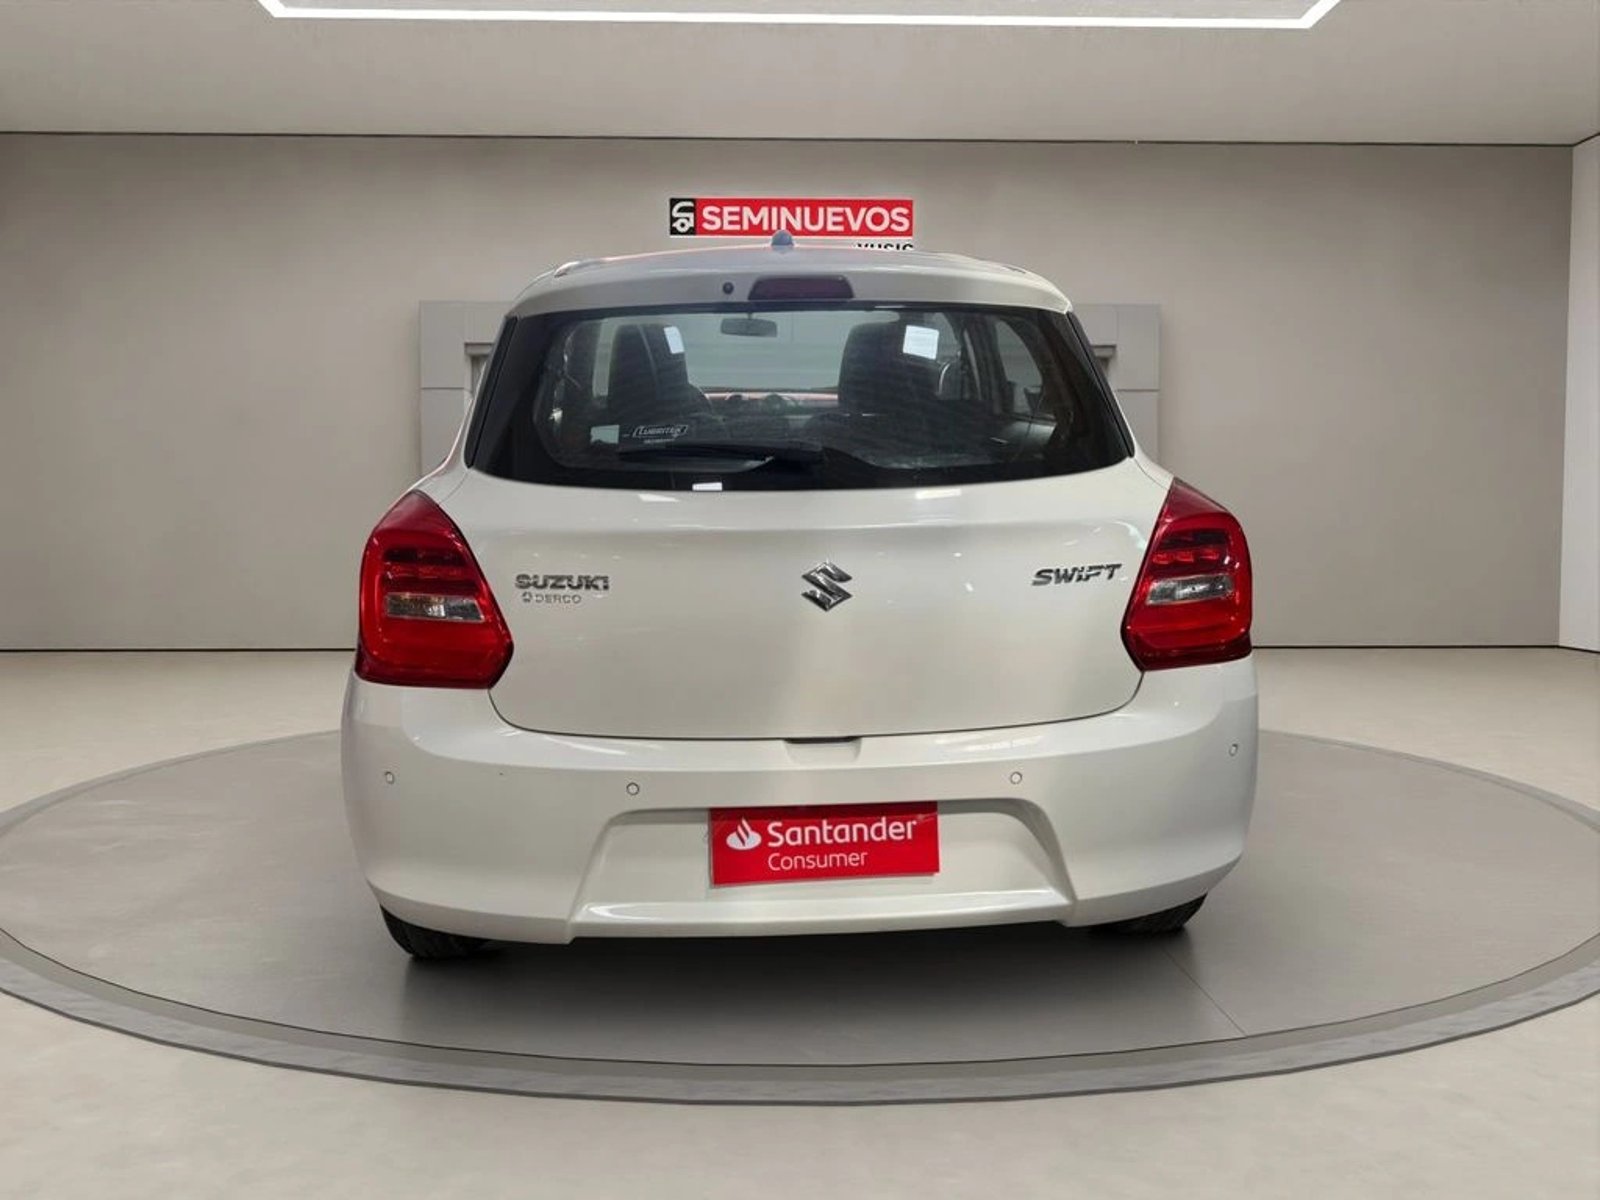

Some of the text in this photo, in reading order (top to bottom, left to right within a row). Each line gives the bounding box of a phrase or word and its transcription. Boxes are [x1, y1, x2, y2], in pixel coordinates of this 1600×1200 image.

[702, 205, 910, 232] SEMINUEVOS
[514, 574, 609, 590] SUZUKI
[1031, 563, 1122, 586] SWIFT
[535, 594, 582, 604] DERCO
[767, 816, 917, 847] Santander
[768, 852, 868, 871] Consumer
